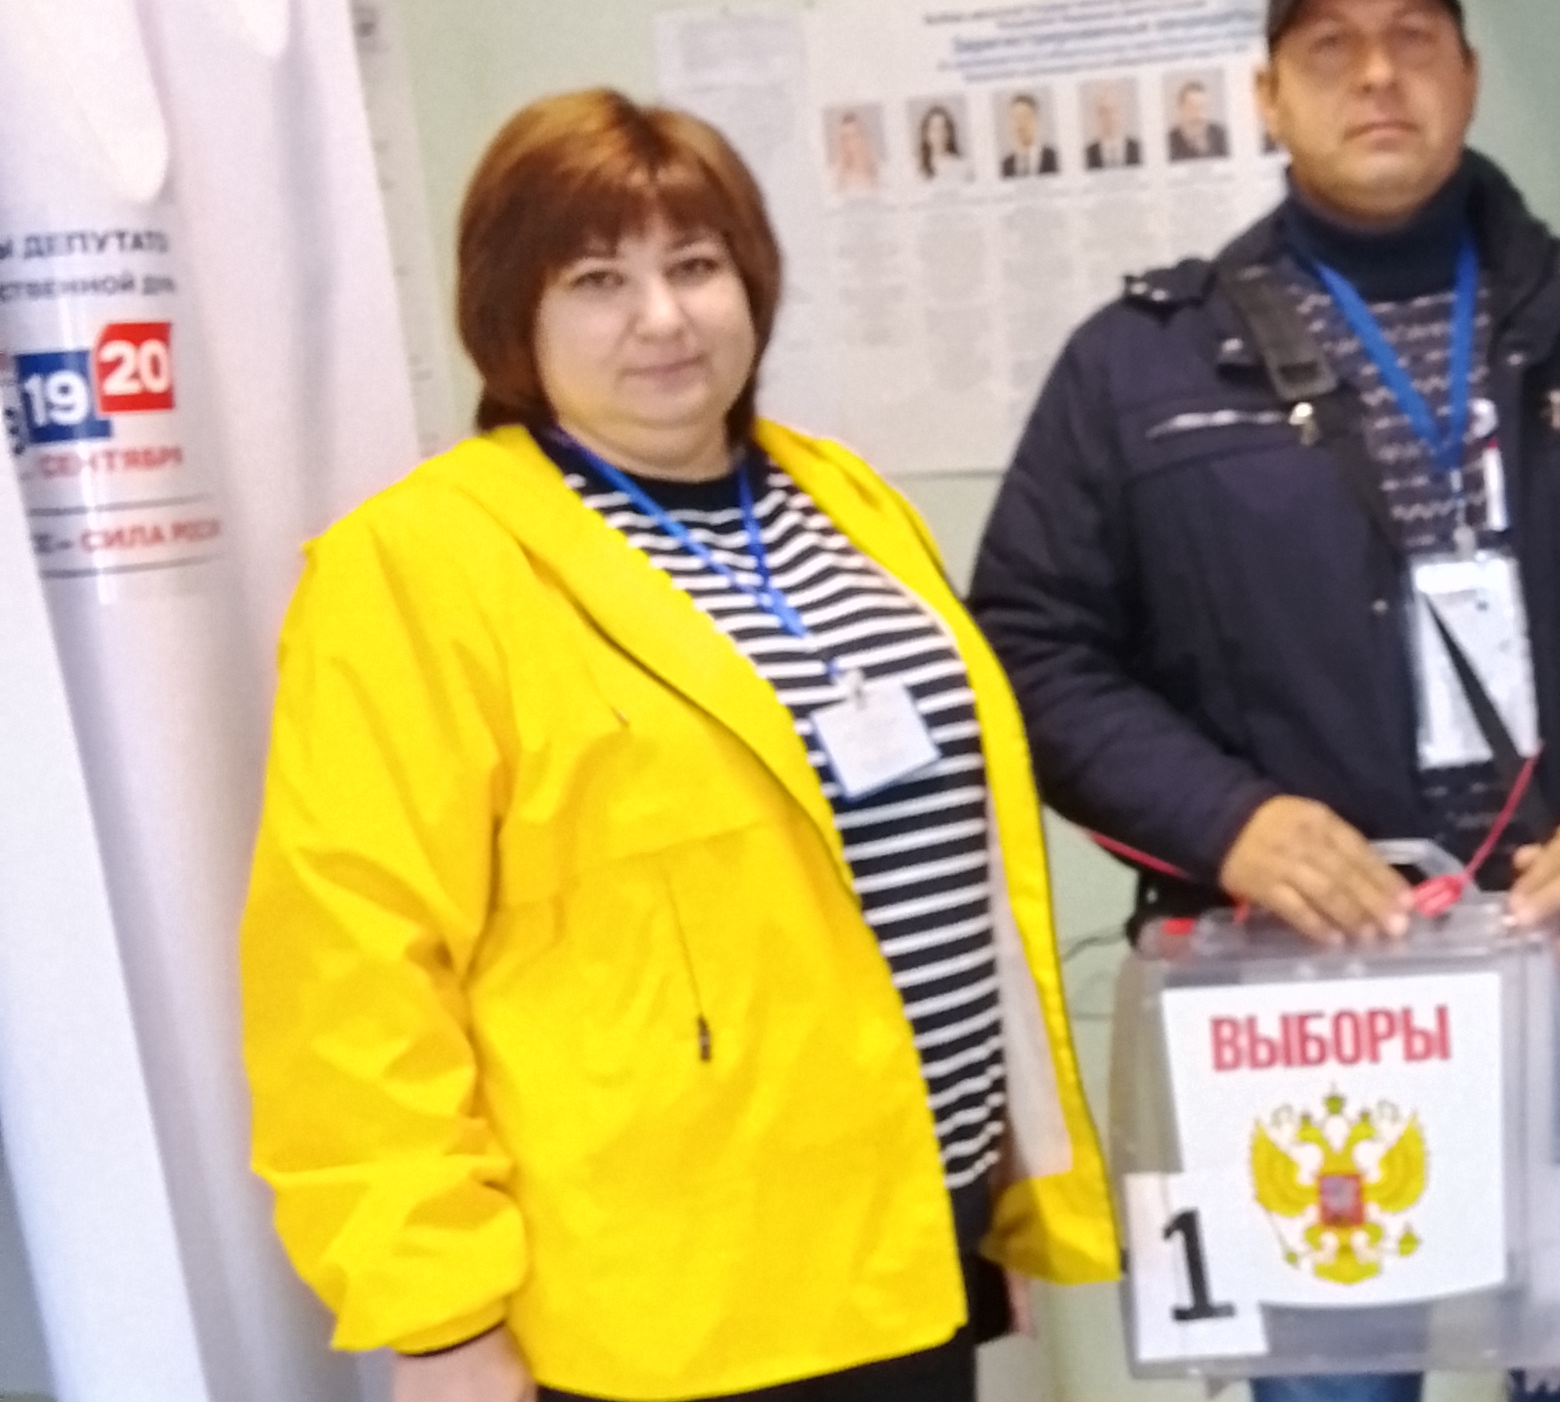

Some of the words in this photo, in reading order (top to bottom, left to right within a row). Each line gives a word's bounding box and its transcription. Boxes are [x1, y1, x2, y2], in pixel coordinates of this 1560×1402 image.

[24, 370, 90, 426] 19
[100, 339, 171, 397] 20
[1210, 1006, 1452, 1072] ВЫБОРЫ
[1161, 1208, 1236, 1321] 1
